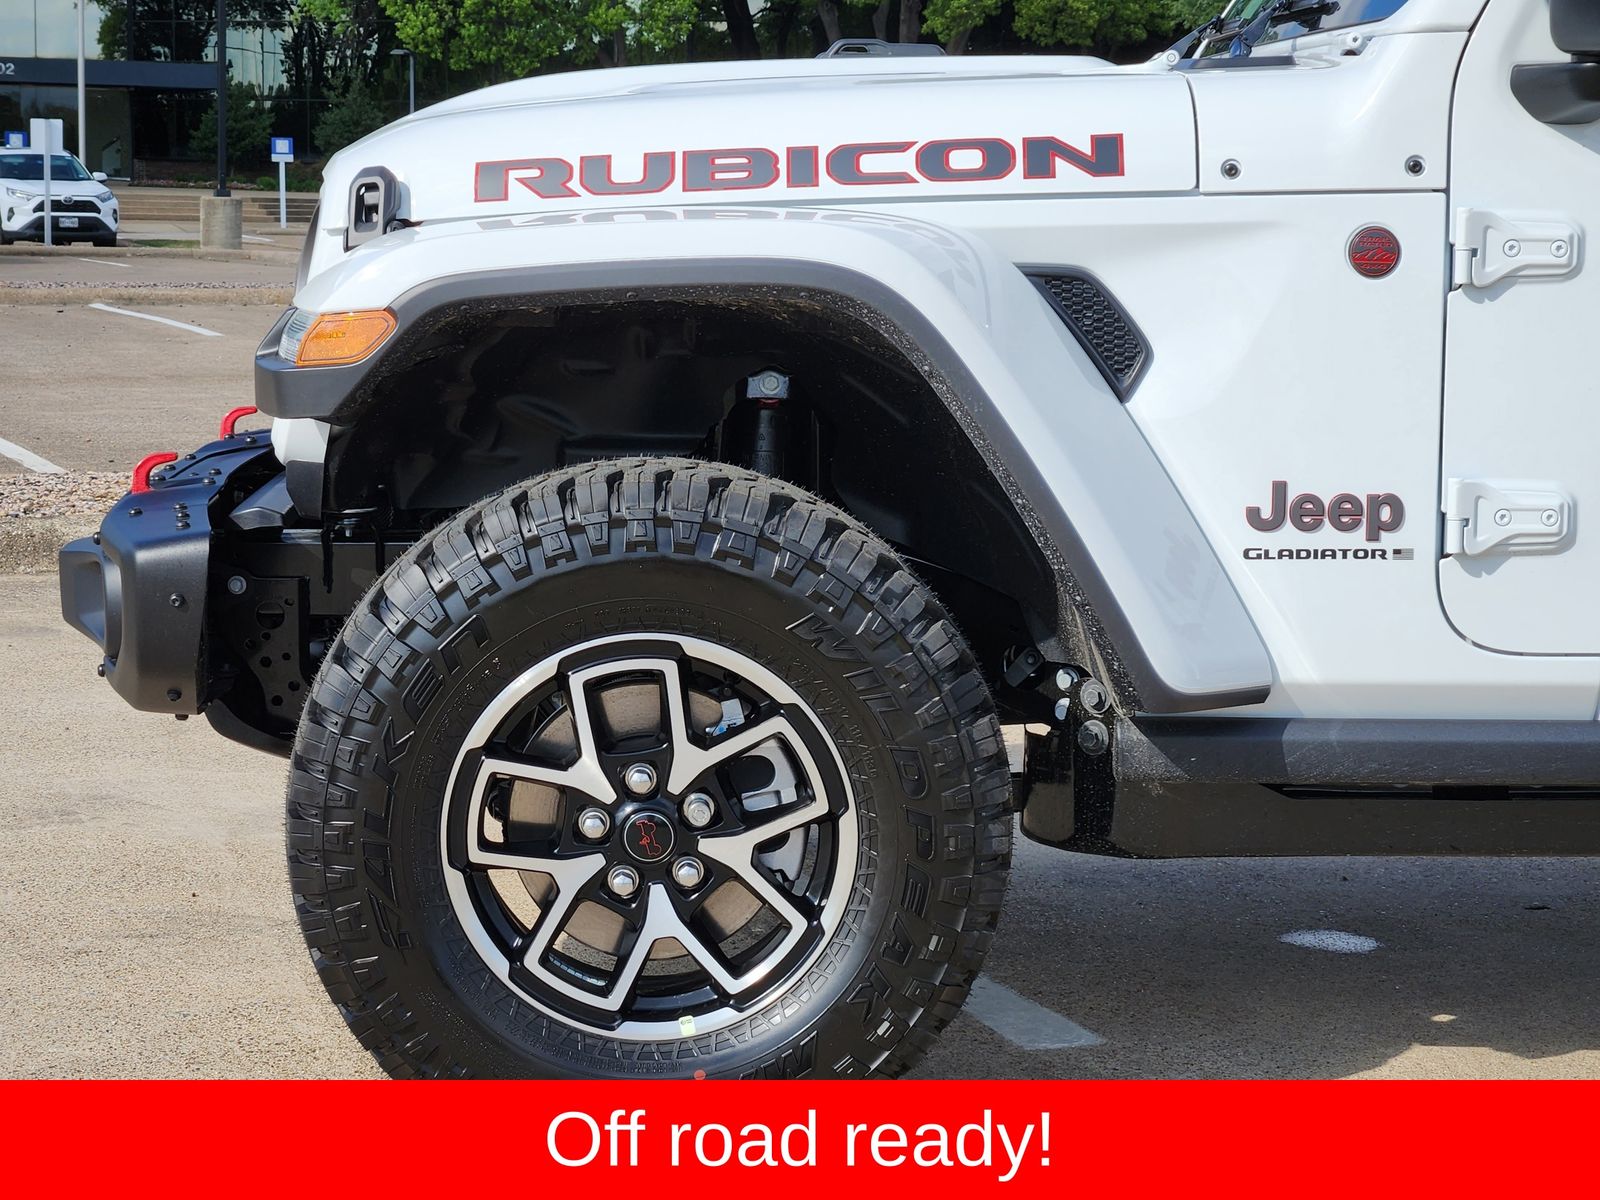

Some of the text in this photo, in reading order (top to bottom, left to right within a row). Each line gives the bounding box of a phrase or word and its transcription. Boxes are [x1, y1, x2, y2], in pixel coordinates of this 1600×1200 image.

[474, 133, 1125, 202] RUBICON
[1245, 480, 1405, 542] Jeep
[1242, 547, 1388, 560] GLADIATOR
